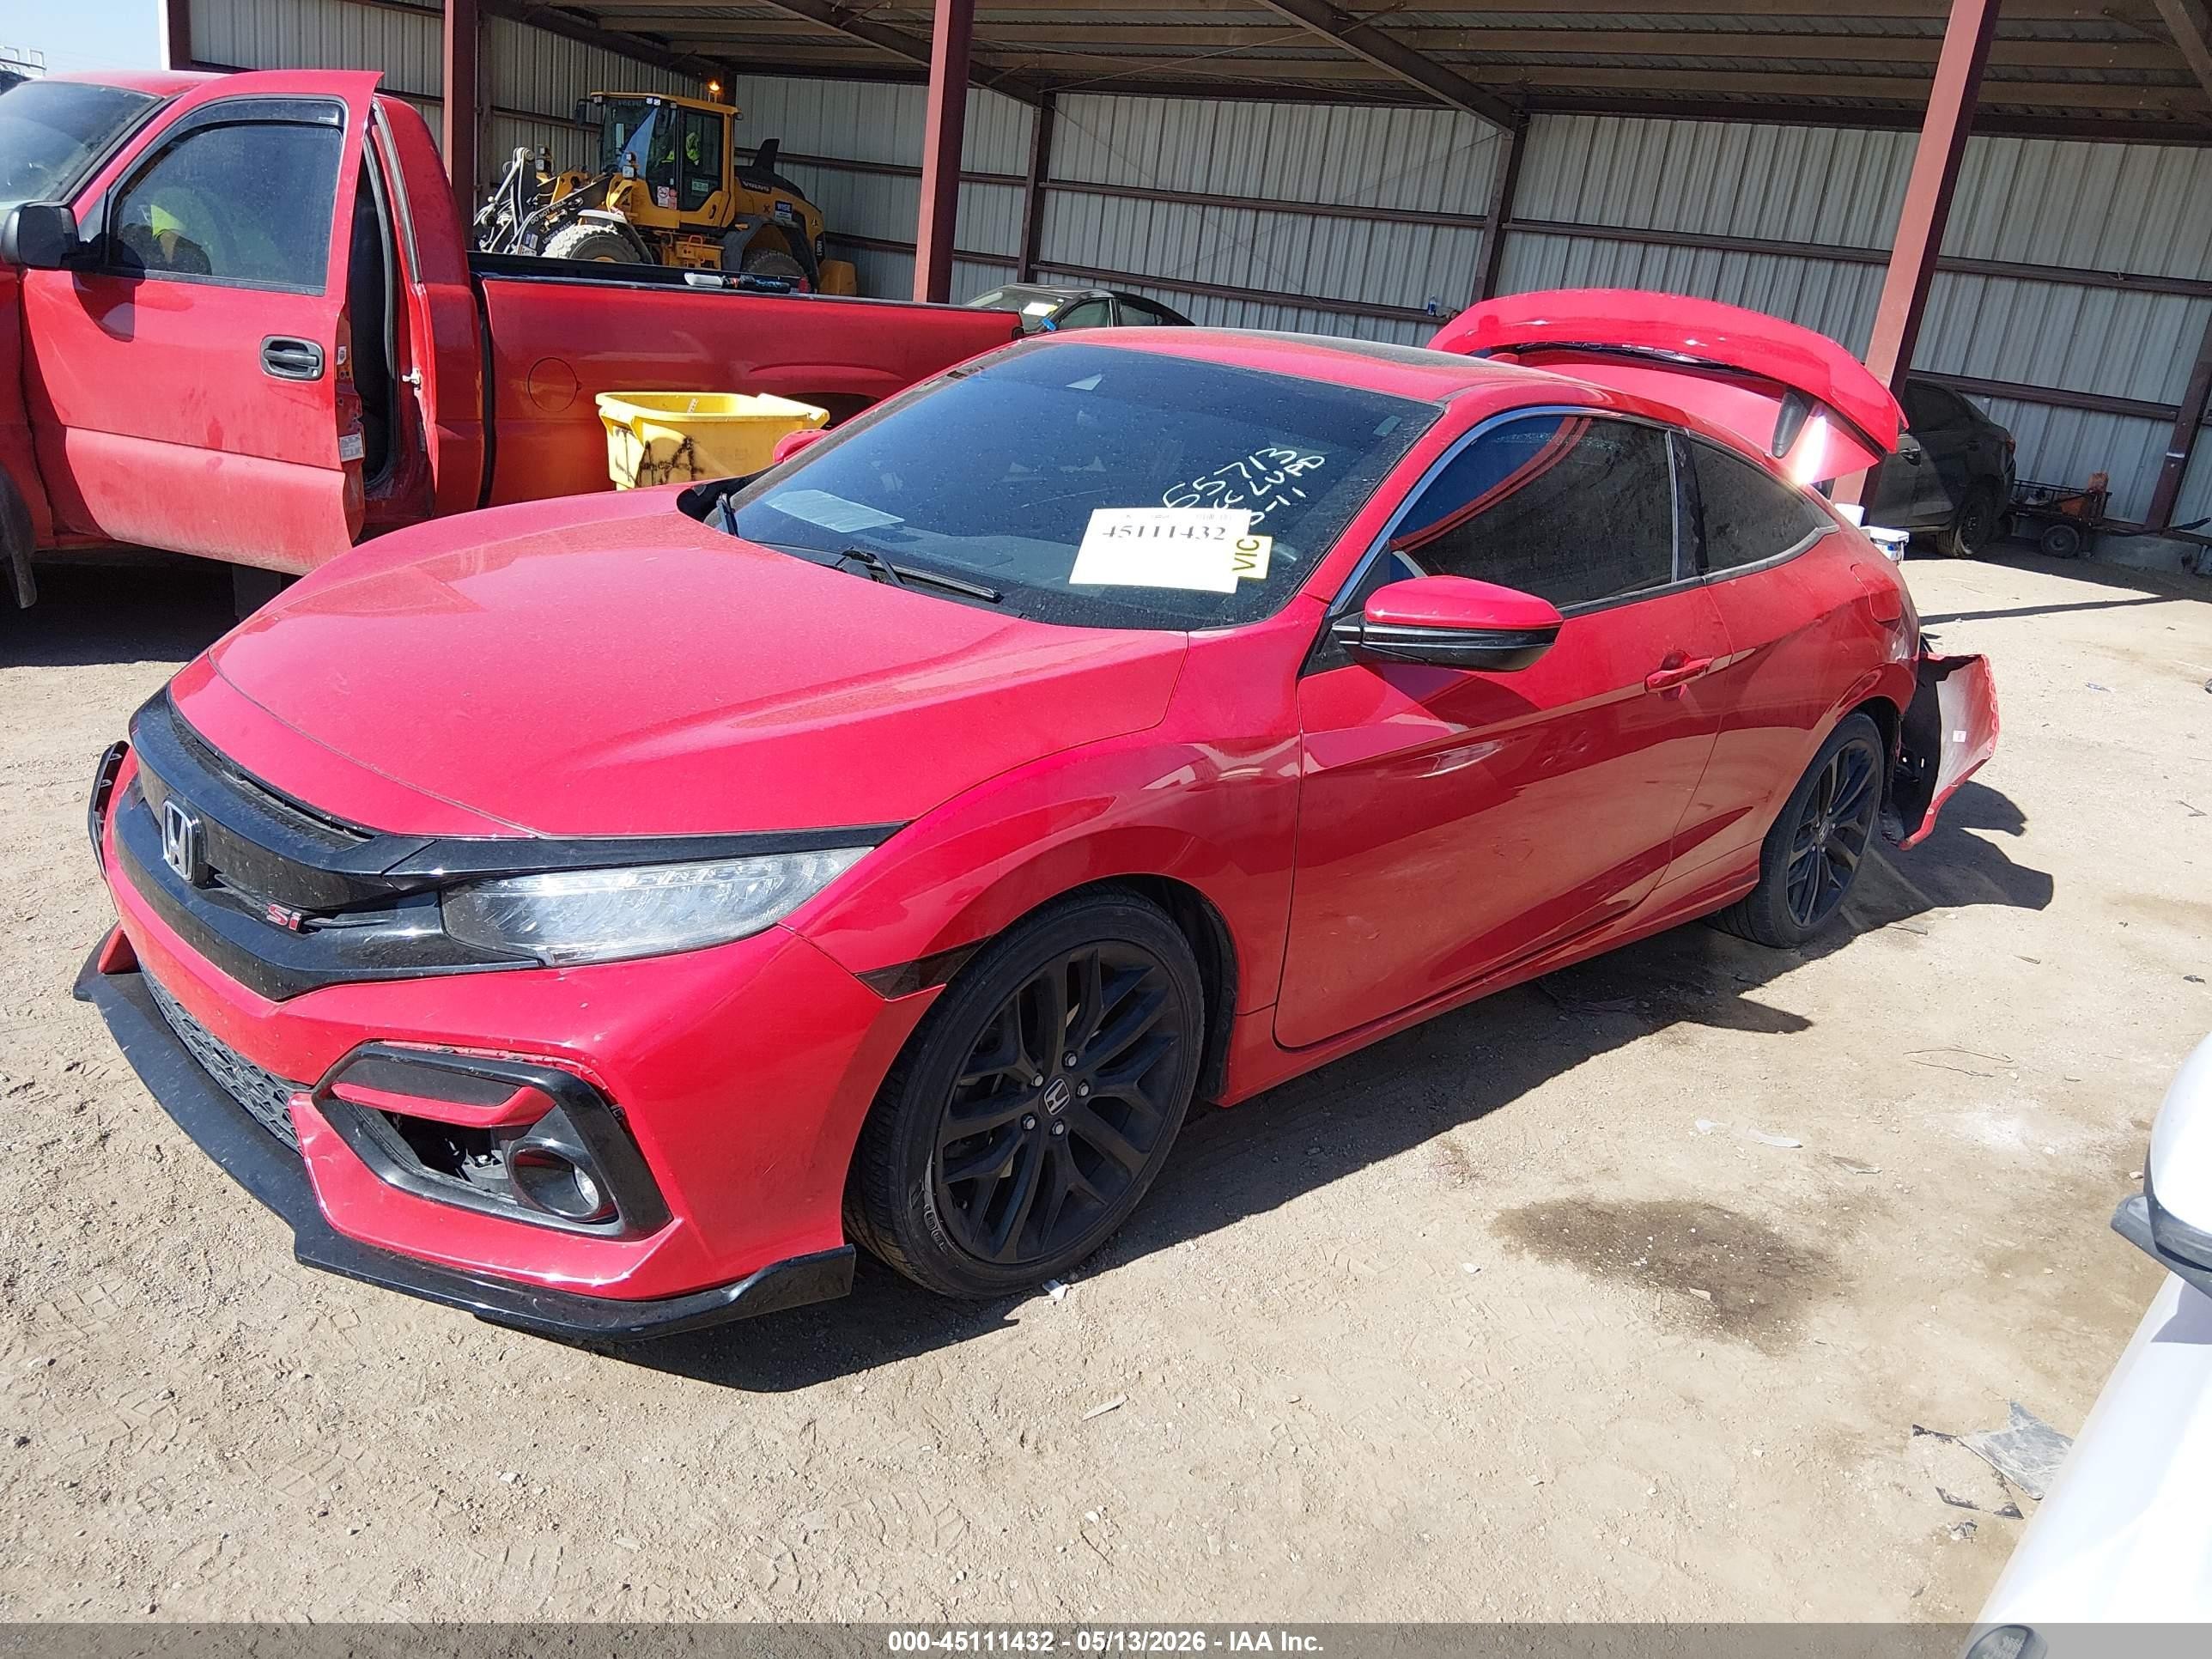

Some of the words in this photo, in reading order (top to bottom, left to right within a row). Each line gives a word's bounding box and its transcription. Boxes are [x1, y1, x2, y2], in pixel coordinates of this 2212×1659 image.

[530, 216, 539, 225] DO
[538, 208, 550, 220] NOT
[550, 199, 567, 211] WALK
[1163, 448, 1297, 508] 65713
[1102, 525, 1226, 541] 45111432
[1231, 538, 1260, 571] VIC
[266, 903, 302, 932] Si
